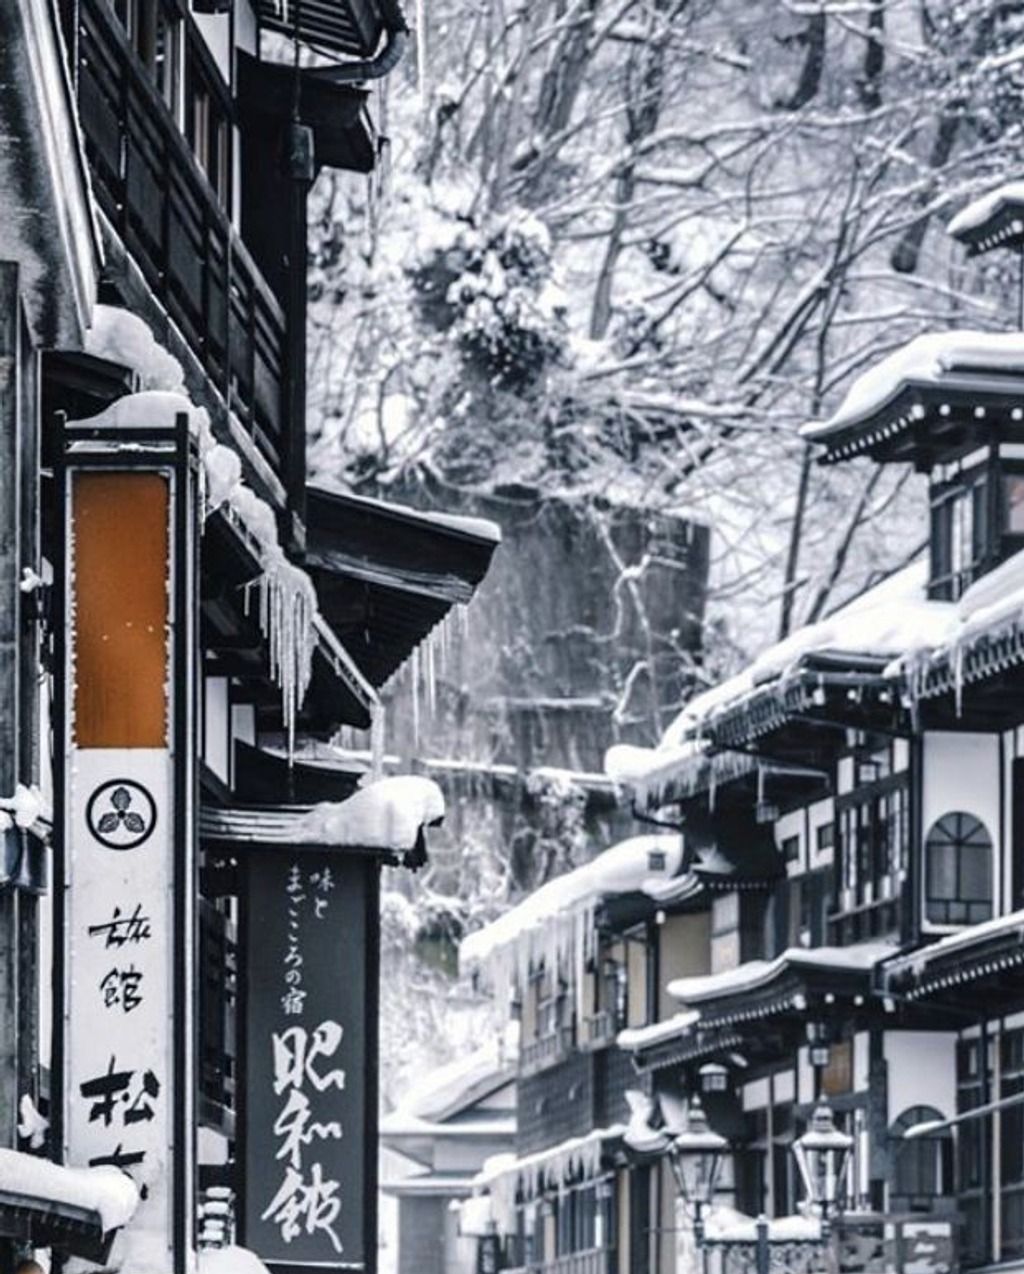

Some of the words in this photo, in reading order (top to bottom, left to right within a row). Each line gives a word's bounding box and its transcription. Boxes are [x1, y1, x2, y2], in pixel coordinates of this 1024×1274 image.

[281, 867, 308, 1015] まごころの宿
[309, 867, 336, 919] 味と
[88, 903, 152, 1013] 旅館
